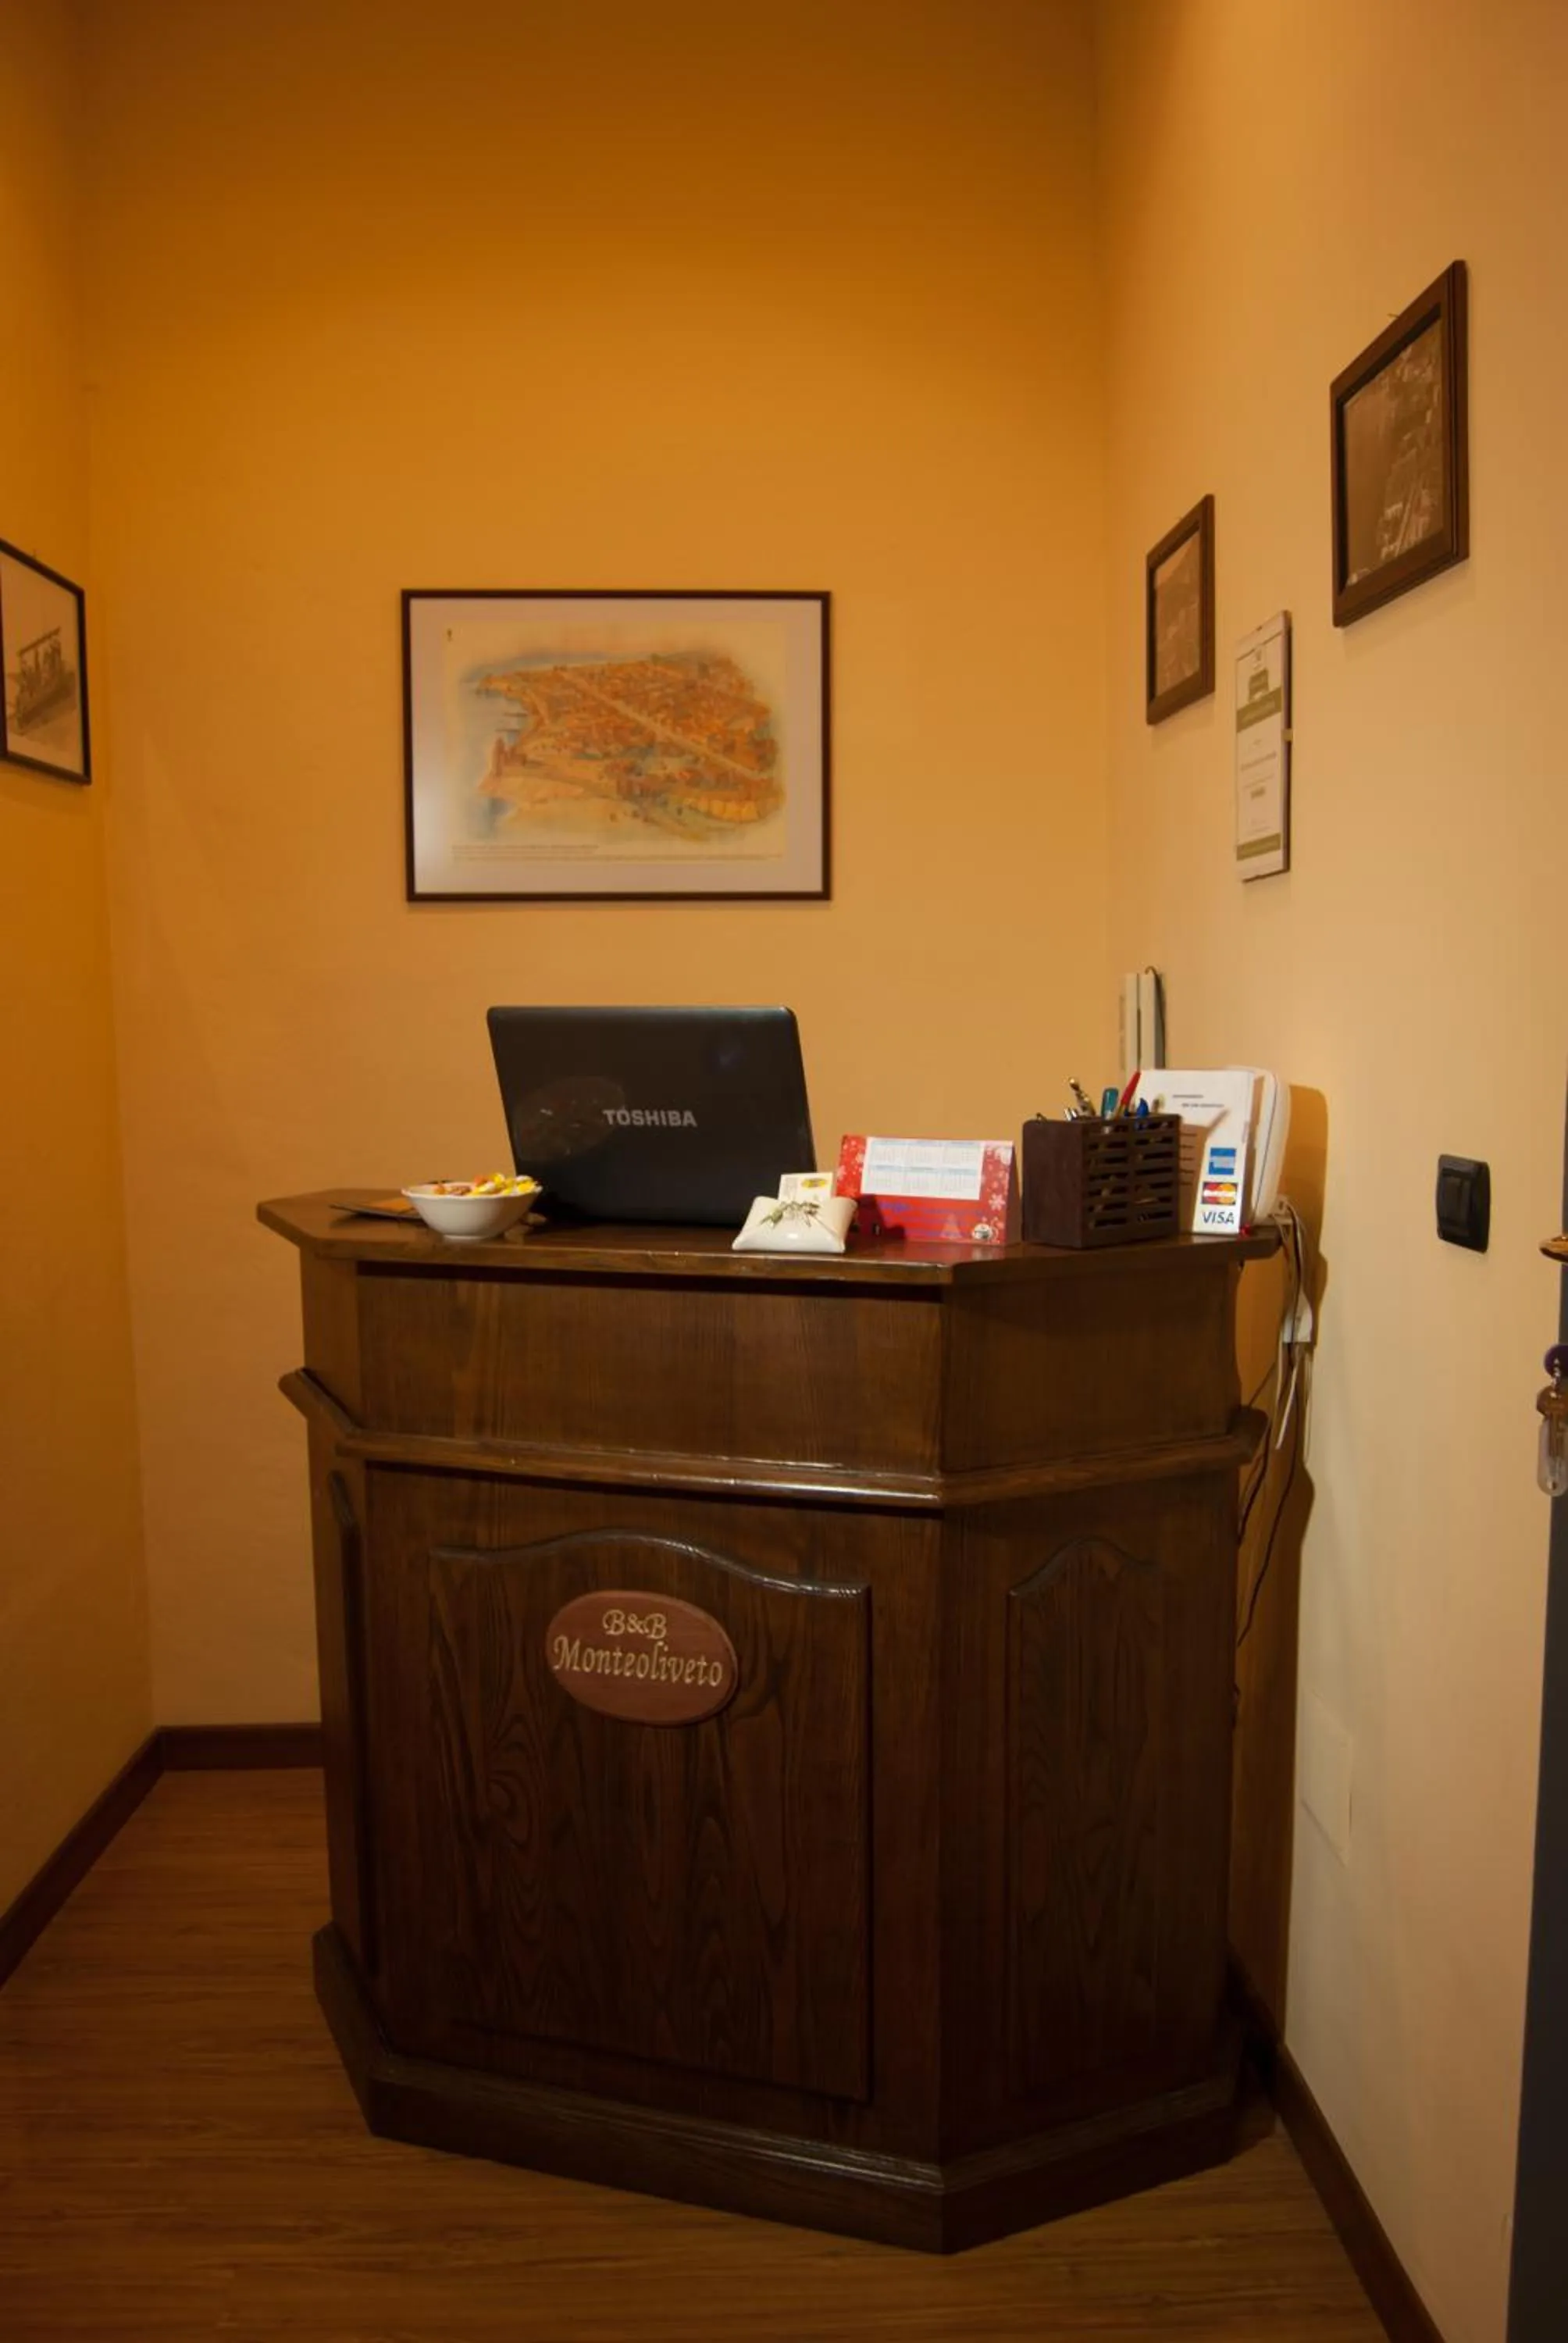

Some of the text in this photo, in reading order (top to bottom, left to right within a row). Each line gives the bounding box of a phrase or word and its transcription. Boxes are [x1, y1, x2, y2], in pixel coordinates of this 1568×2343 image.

[602, 1109, 697, 1127] TOSHIBA
[1202, 1211, 1235, 1225] VISA
[602, 1609, 668, 1639] B&B
[553, 1635, 723, 1687] Monteoliveto
